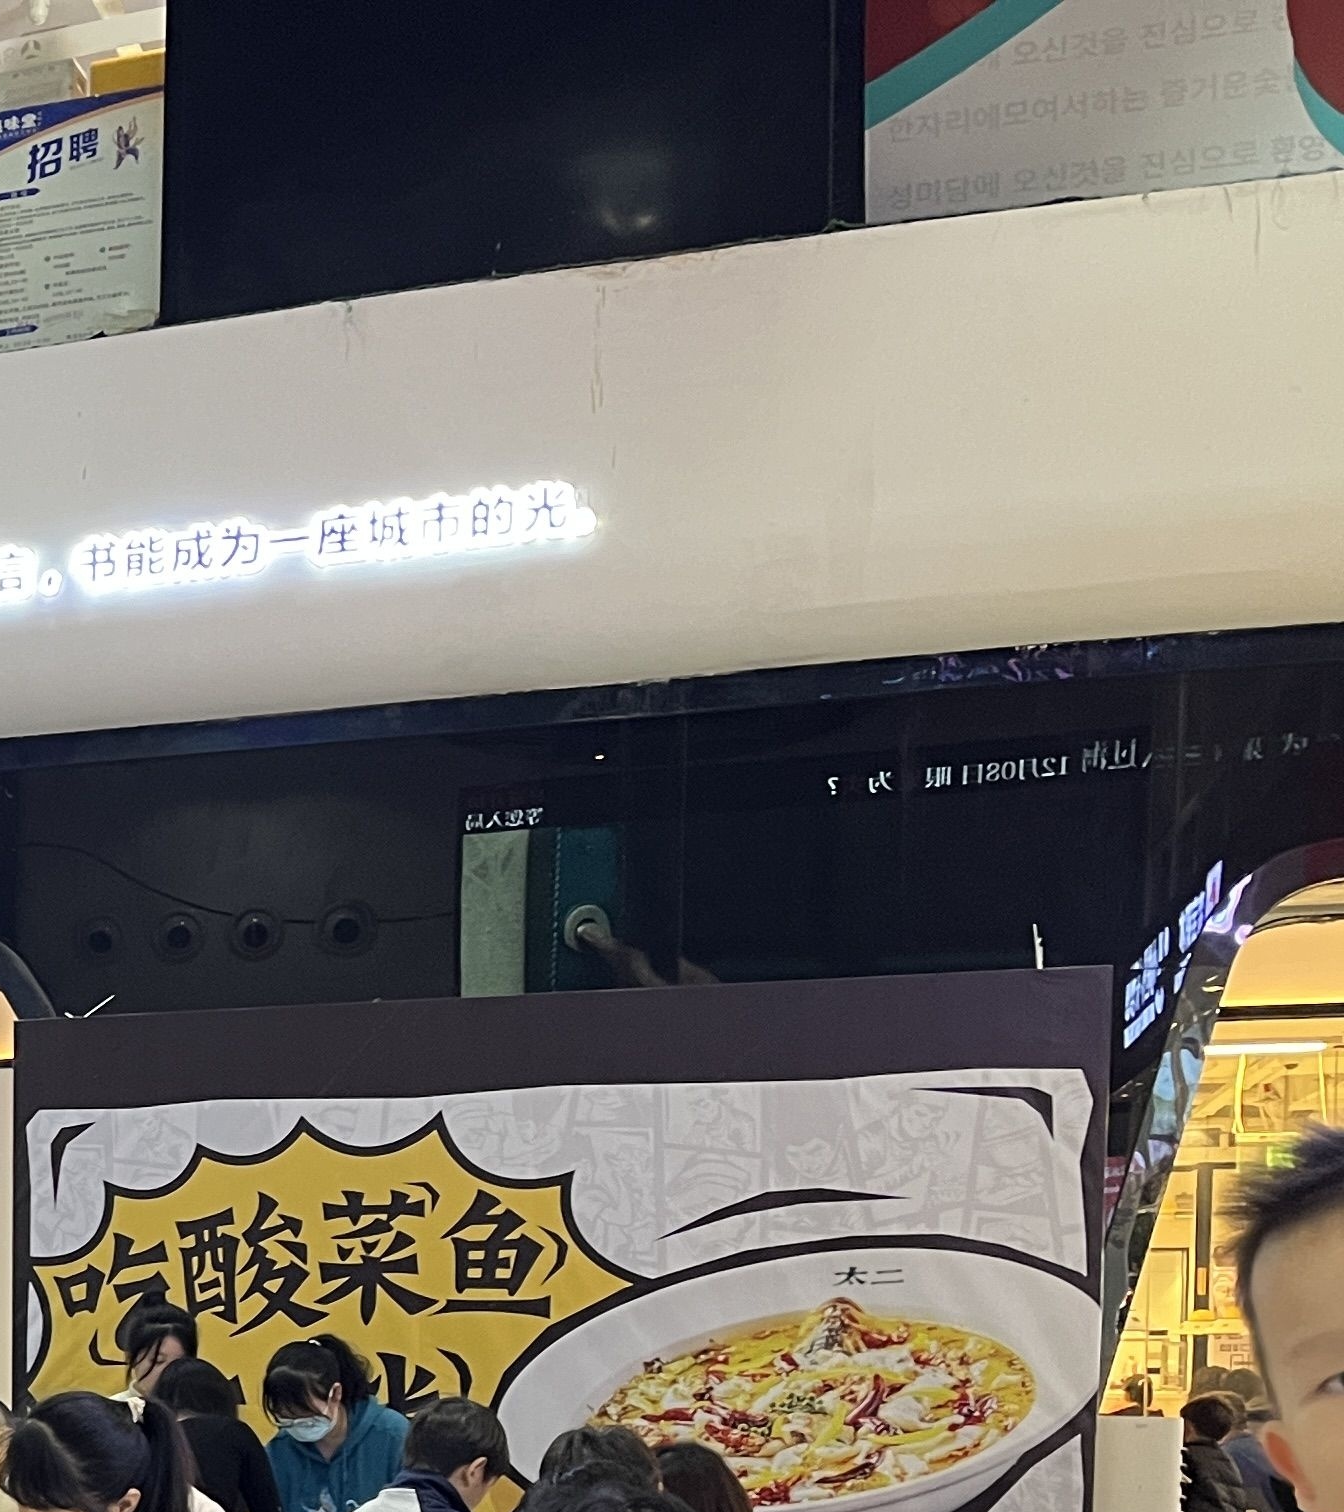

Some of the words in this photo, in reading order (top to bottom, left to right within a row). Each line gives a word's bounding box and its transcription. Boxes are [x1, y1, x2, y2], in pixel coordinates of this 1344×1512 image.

[26, 127, 100, 184] 招聘
[53, 1188, 553, 1366] 吃酸菜鱼
